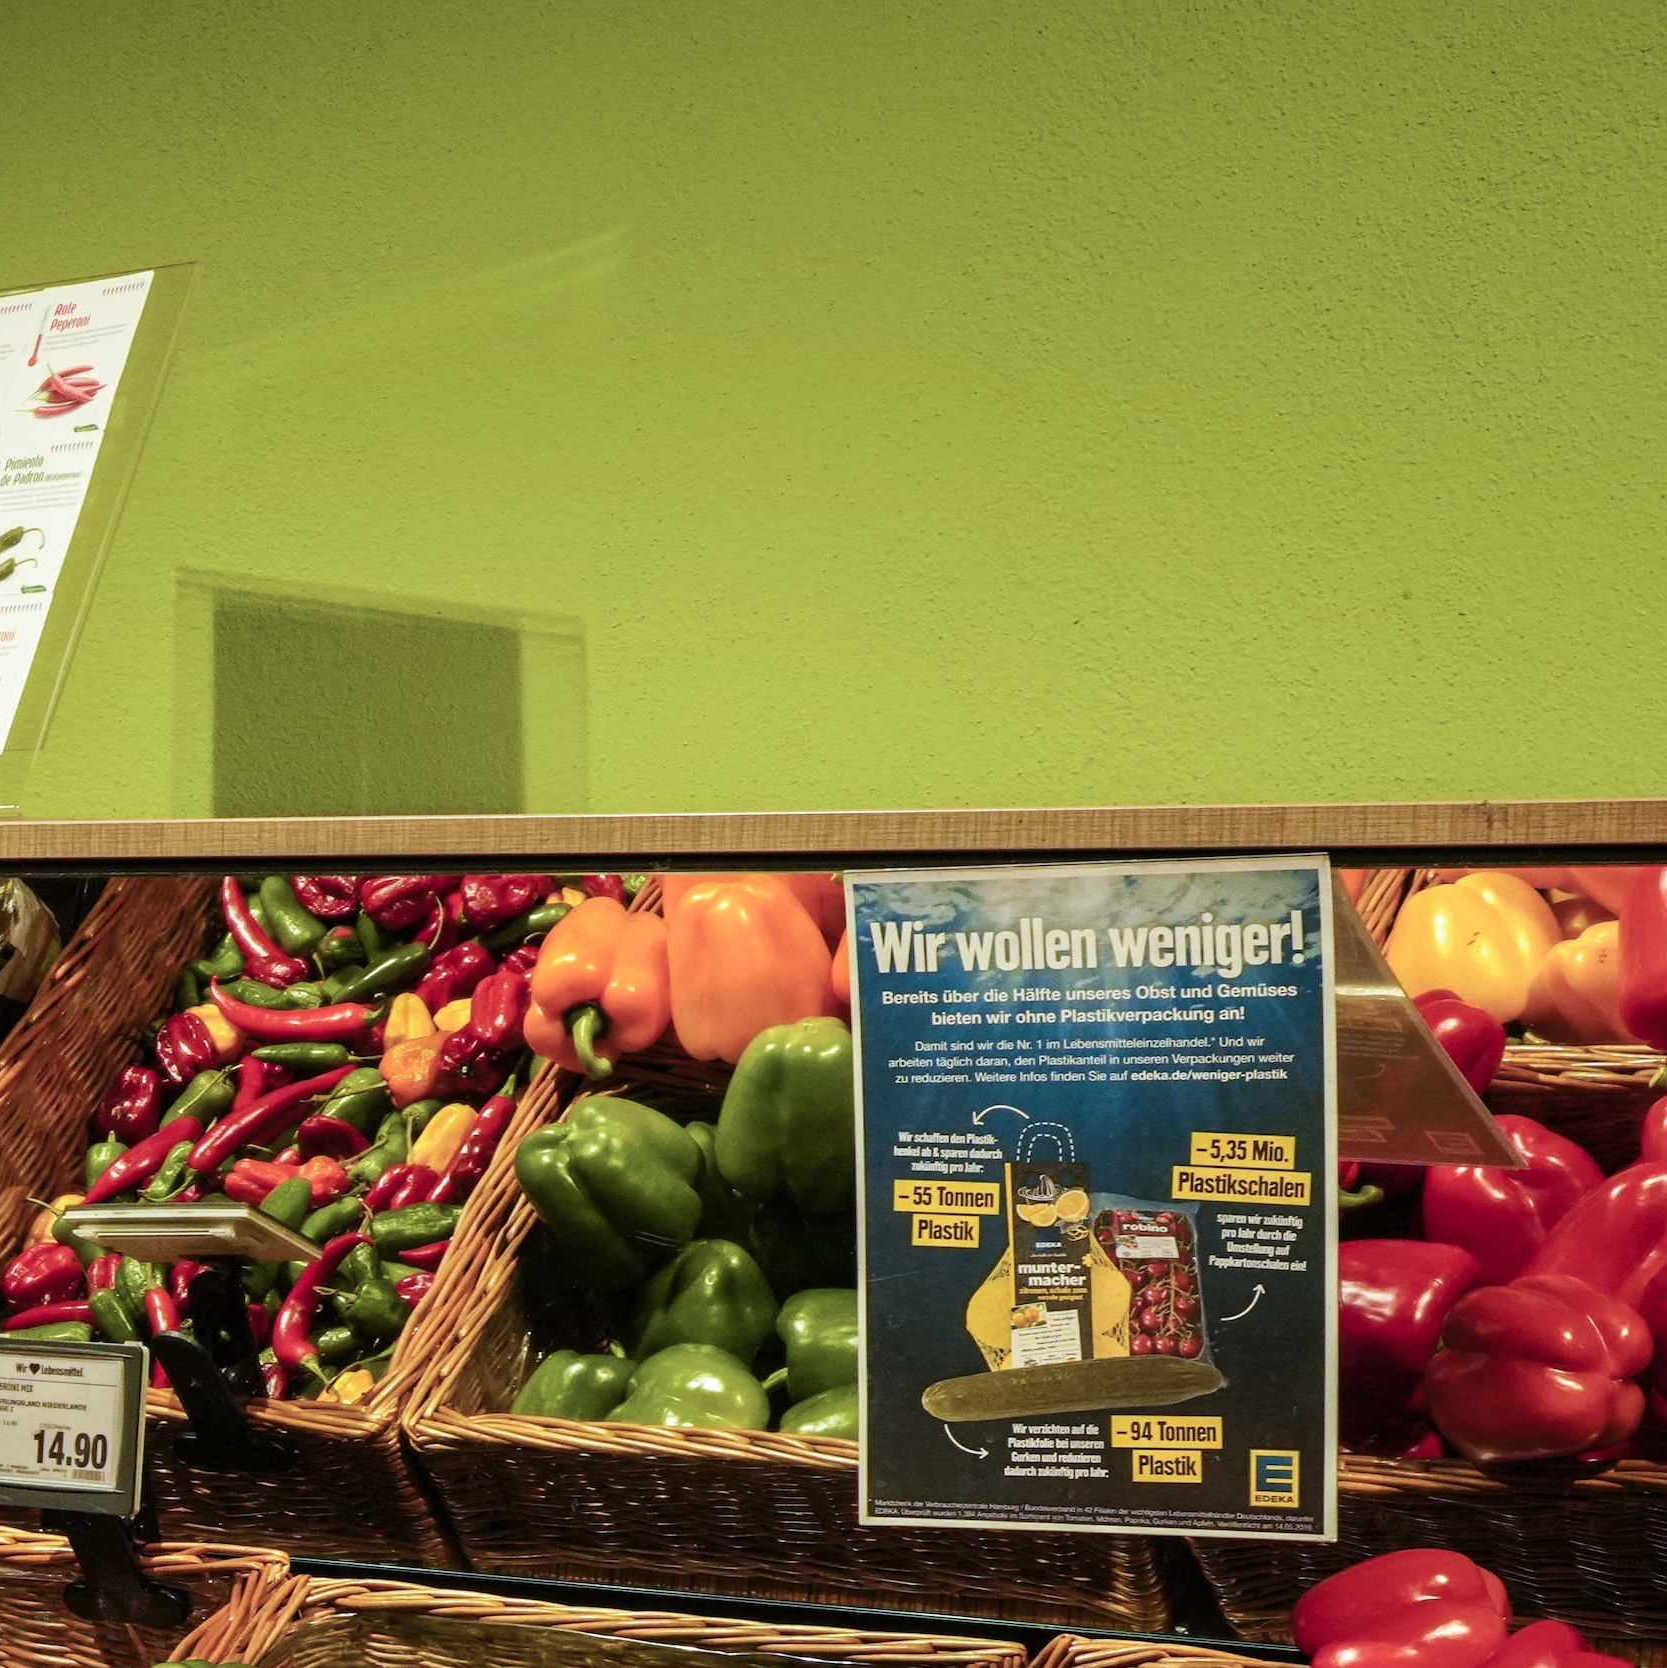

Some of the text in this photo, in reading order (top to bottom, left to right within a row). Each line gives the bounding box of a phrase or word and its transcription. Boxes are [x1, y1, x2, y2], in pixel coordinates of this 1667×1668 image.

[50, 313, 91, 331] Peperoni
[5, 456, 44, 471] Pimiento
[0, 472, 44, 487] de Padron
[869, 910, 1305, 978] Wir wollen weniger!
[882, 984, 1298, 1005] Bereits über die Hälfte unseres Obst und Gemüses
[932, 1007, 1245, 1025] bieten wir ohne Plastikverpackung an!
[915, 1041, 948, 1051] Damit
[950, 1041, 974, 1050] sind
[977, 1041, 994, 1050] wir
[997, 1040, 1014, 1050] die
[1046, 1039, 1060, 1049] im
[1219, 1037, 1244, 1047] Und
[1247, 1037, 1265, 1046] wir
[888, 1053, 1295, 1069] arbeiten täglich den Plastikanteil in unseren Verpackungen weiter
[974, 1070, 1128, 1082] Weitere Infos finden Sie auf
[1210, 1139, 1289, 1163] 5,35 Mio.
[1178, 1172, 1305, 1198] Plastikschalen
[913, 1186, 994, 1208] 55 Tonnen
[917, 1220, 975, 1241] Plastik
[1122, 1223, 1169, 1233] robino
[1018, 1263, 1081, 1275] munter-
[1028, 1275, 1087, 1287] macher
[41, 1365, 83, 1377] Lebensmittel
[21, 1384, 34, 1393] MIX
[1130, 1422, 1216, 1442] 94 Tonnen
[34, 1430, 108, 1469] 14.90
[1138, 1455, 1196, 1476] Plastik
[1255, 1495, 1293, 1504] EDEKA
